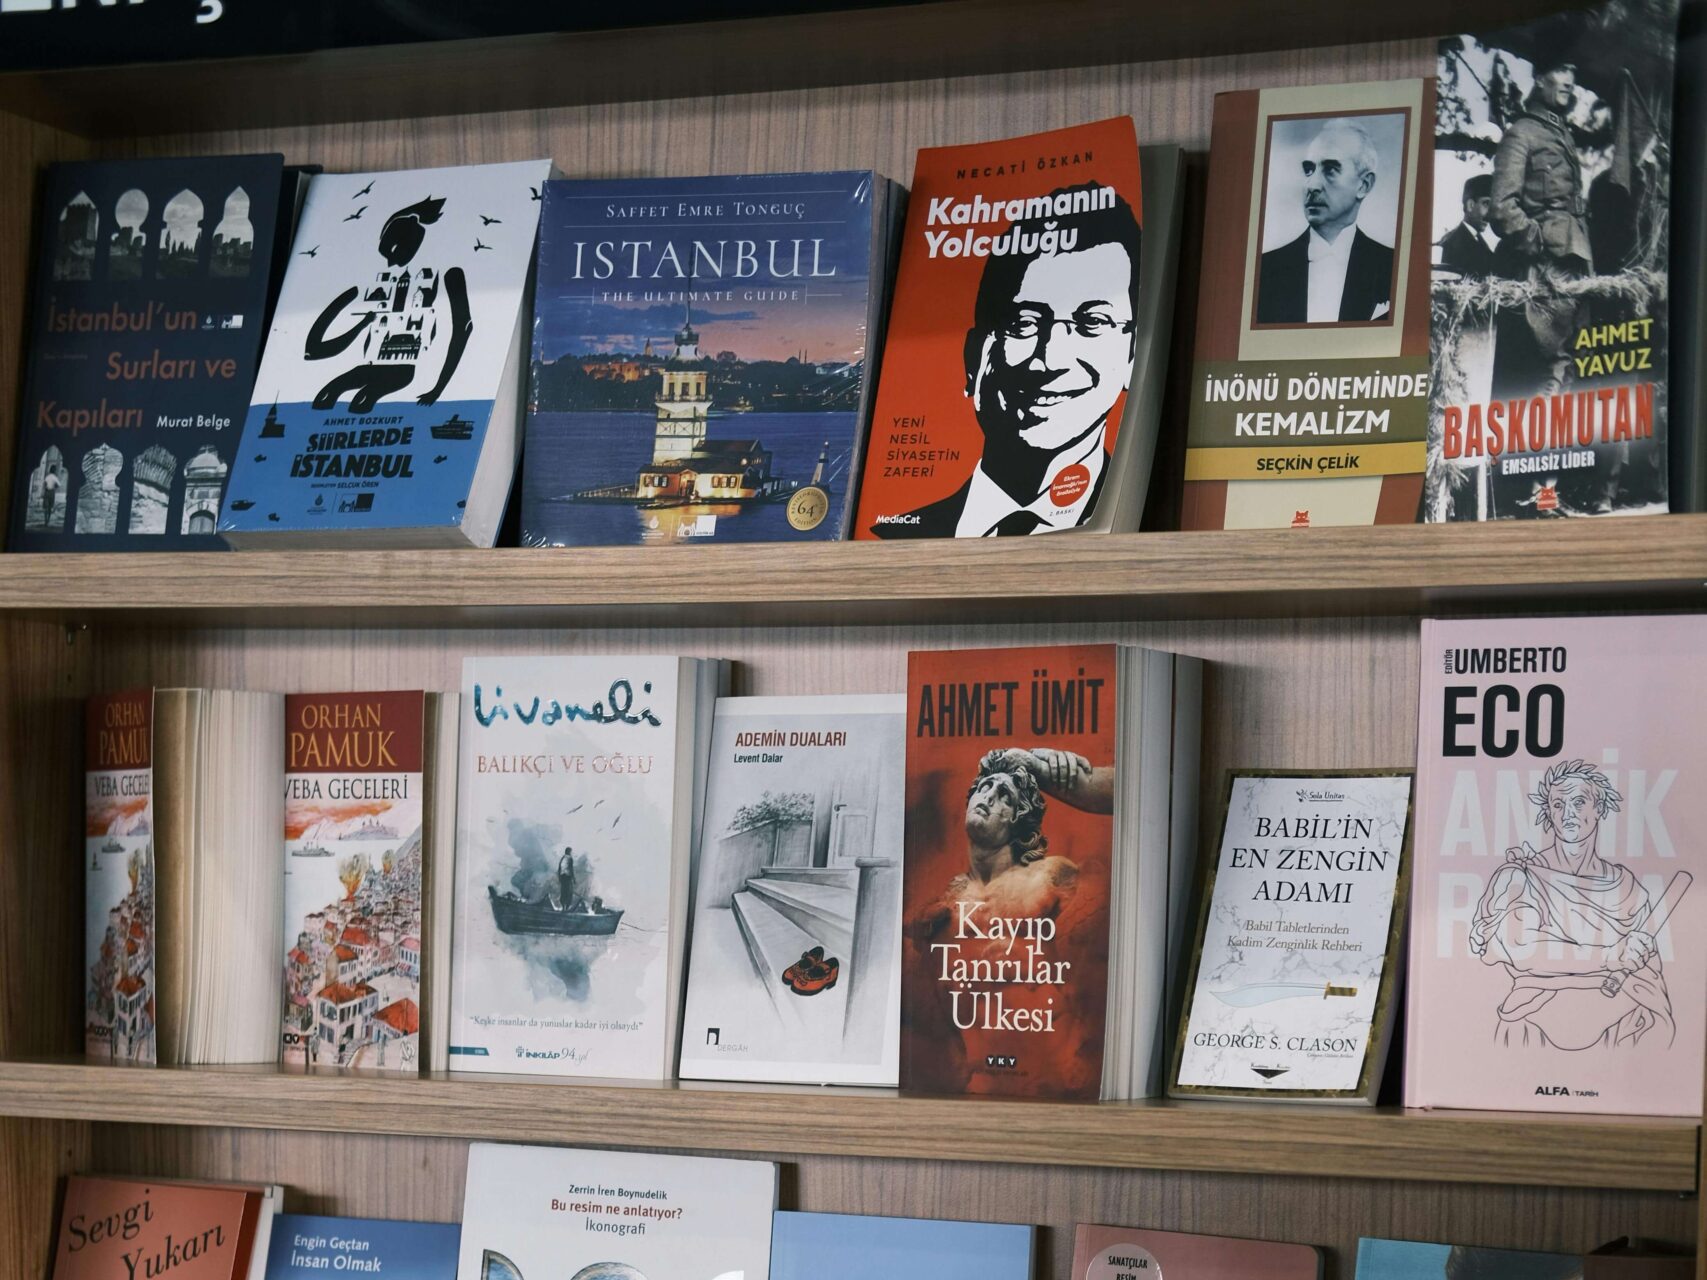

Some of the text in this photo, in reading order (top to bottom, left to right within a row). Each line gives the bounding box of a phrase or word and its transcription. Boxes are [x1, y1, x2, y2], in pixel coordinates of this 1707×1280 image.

[957, 151, 1094, 179] NECATİ ÖZKAN
[606, 203, 724, 218] SAFFET EMRE
[926, 186, 1116, 226] Kahramanın
[924, 221, 1078, 259] Yolculuğu
[571, 239, 836, 280] ISTANBUL
[601, 290, 799, 302] THE ULTIMATE GUIDE
[1575, 318, 1654, 350] AHMET
[106, 349, 237, 380] Surları ve
[1575, 348, 1652, 378] YAVUZ
[1205, 370, 1428, 402] İNÖNÜ DÖNEMİNDE
[37, 398, 231, 437] Kapıları Murat Belge
[323, 416, 404, 426] AHMET BOZKURT
[892, 415, 925, 428] YENİ
[1235, 404, 1390, 436] KEMALİZM
[1443, 383, 1654, 467] BAŞKOMUTAN
[890, 432, 931, 445] NESİL
[290, 454, 414, 478] İSTANBUL
[887, 447, 960, 461] SİYASETİN
[1257, 452, 1360, 474] SEÇKİN ÇELİK
[1502, 450, 1595, 475] EMSALSİZ LİDER
[883, 464, 934, 478] ZAFERİ
[876, 514, 921, 525] MediaCat
[1454, 646, 1567, 674] UMBERTO
[105, 701, 145, 727] ORHAN
[917, 667, 1105, 738] AHMET ÜMİT
[301, 704, 382, 730] ORHAN
[1442, 683, 1565, 758] ECO
[290, 731, 398, 768] PAMUK
[735, 729, 847, 747] ADEMİN DUALARI
[477, 752, 654, 778] BALIKÇI VE OĞLU
[733, 753, 783, 763] Levent Dalar
[96, 775, 119, 797] VEBA
[328, 774, 409, 800] GECELERİ
[1229, 846, 1389, 872] EN ZENGİN
[1252, 880, 1354, 904] ADAMI
[954, 901, 1056, 956] Kayıp
[1244, 919, 1350, 935] Babil Tabletlerinden
[1227, 935, 1363, 952] Kadim Zenginlik Rehberi
[930, 943, 1071, 985] Tanrılar
[949, 982, 1055, 1032] Ülkesi
[1193, 1032, 1358, 1052] GEORGE S. CLASON
[1535, 1086, 1570, 1096] ALFA
[569, 1184, 667, 1200] Zerrin Boynudelik
[68, 1188, 154, 1253] Sevgi
[551, 1199, 683, 1221] Bu resim ne anlatıyor?
[585, 1216, 646, 1236] İkonografi
[294, 1234, 370, 1253] Engin Geçtan
[333, 1255, 382, 1272] Olmak
[1108, 1255, 1148, 1269] SANATÇILAR
